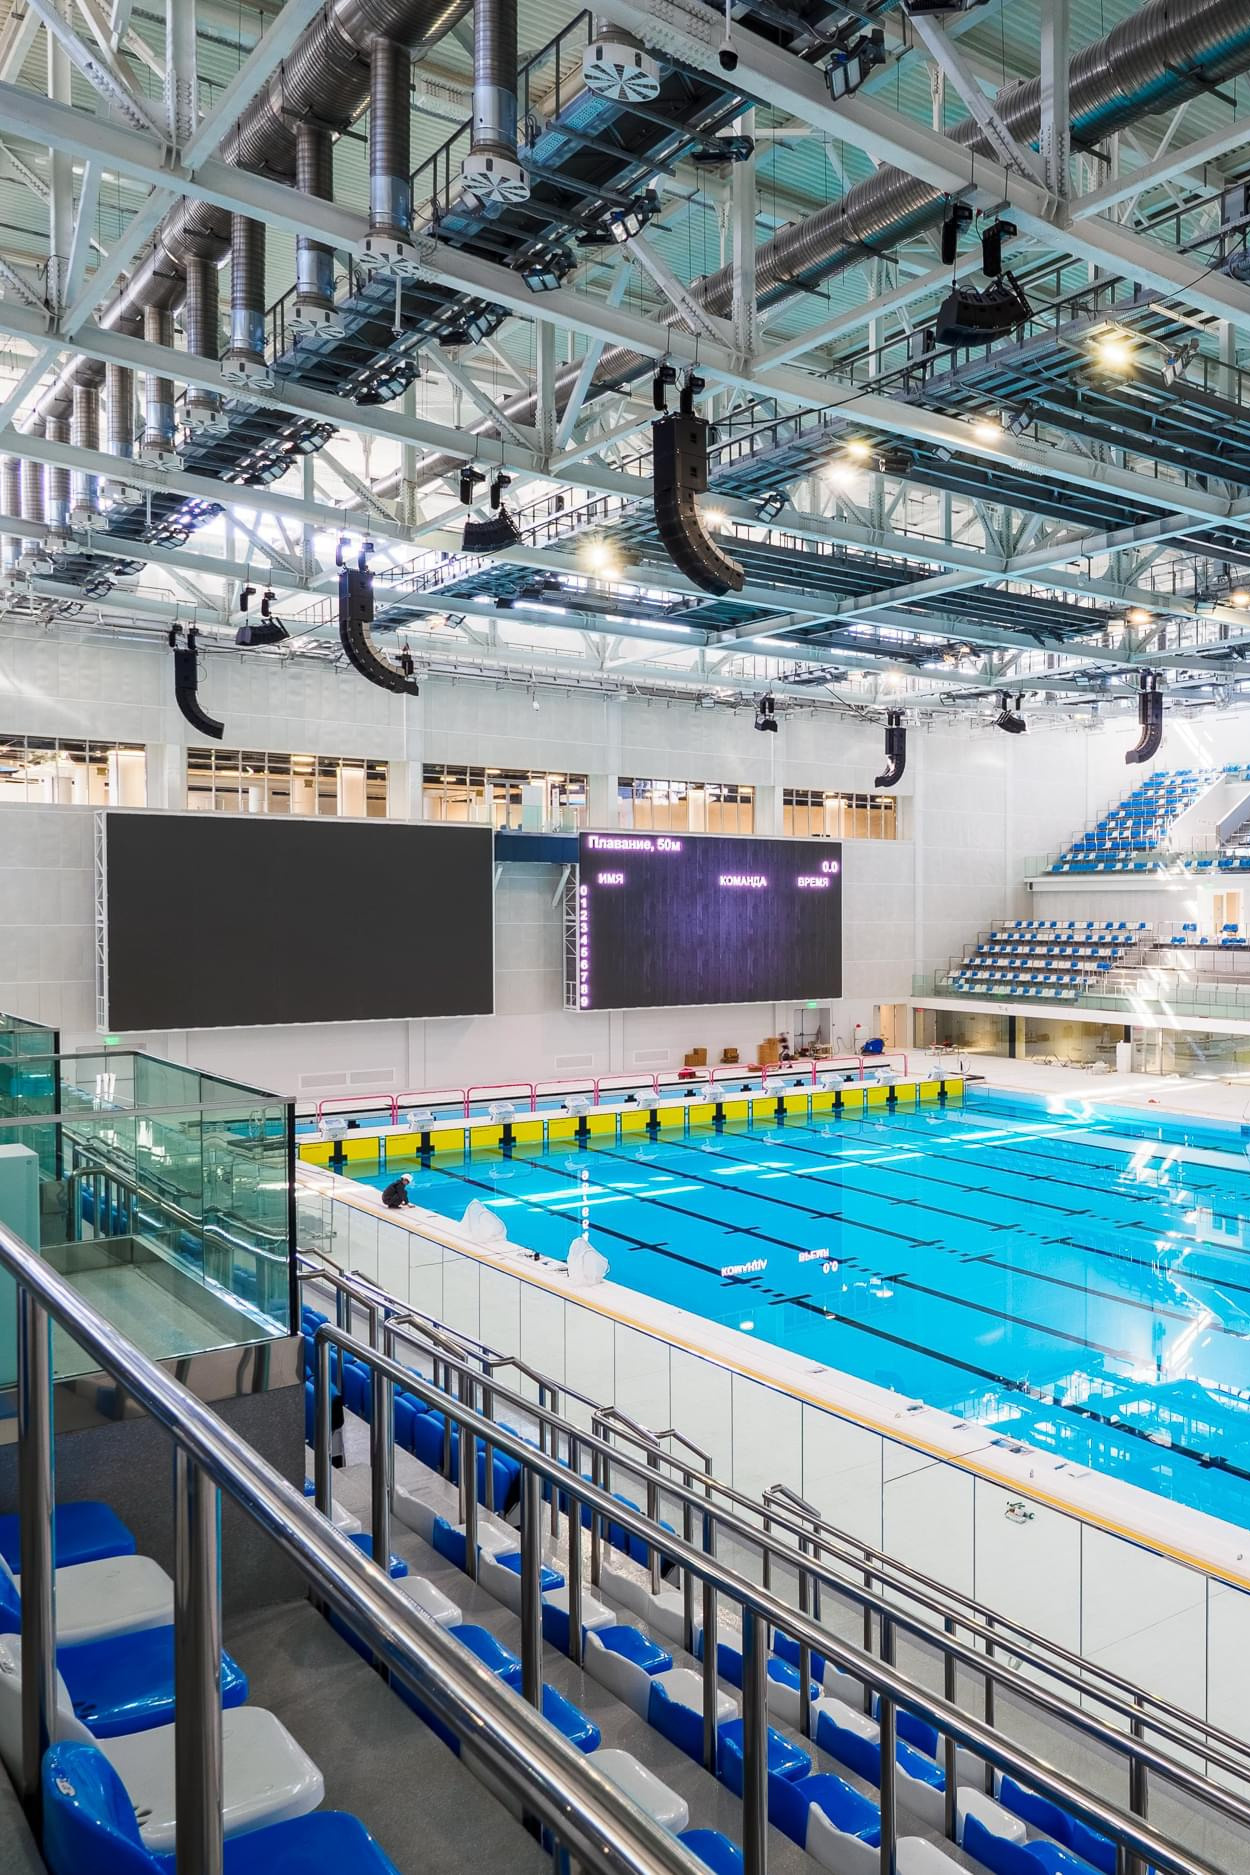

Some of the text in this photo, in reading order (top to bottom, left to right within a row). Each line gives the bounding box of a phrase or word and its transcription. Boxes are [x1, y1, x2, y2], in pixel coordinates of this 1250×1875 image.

[588, 835, 680, 852] Плавание, 50м
[822, 861, 838, 873] 0.0
[598, 873, 624, 884] ИМЯ
[720, 876, 767, 888] КОМАНДА
[798, 877, 829, 887] ВРЕМЯ
[580, 885, 587, 896] 0
[580, 897, 587, 908] 1
[580, 910, 587, 920] 2
[580, 922, 587, 933] 3
[580, 934, 587, 945] 4
[580, 959, 588, 970] 6
[580, 971, 588, 982] 7
[580, 996, 588, 1007] 9
